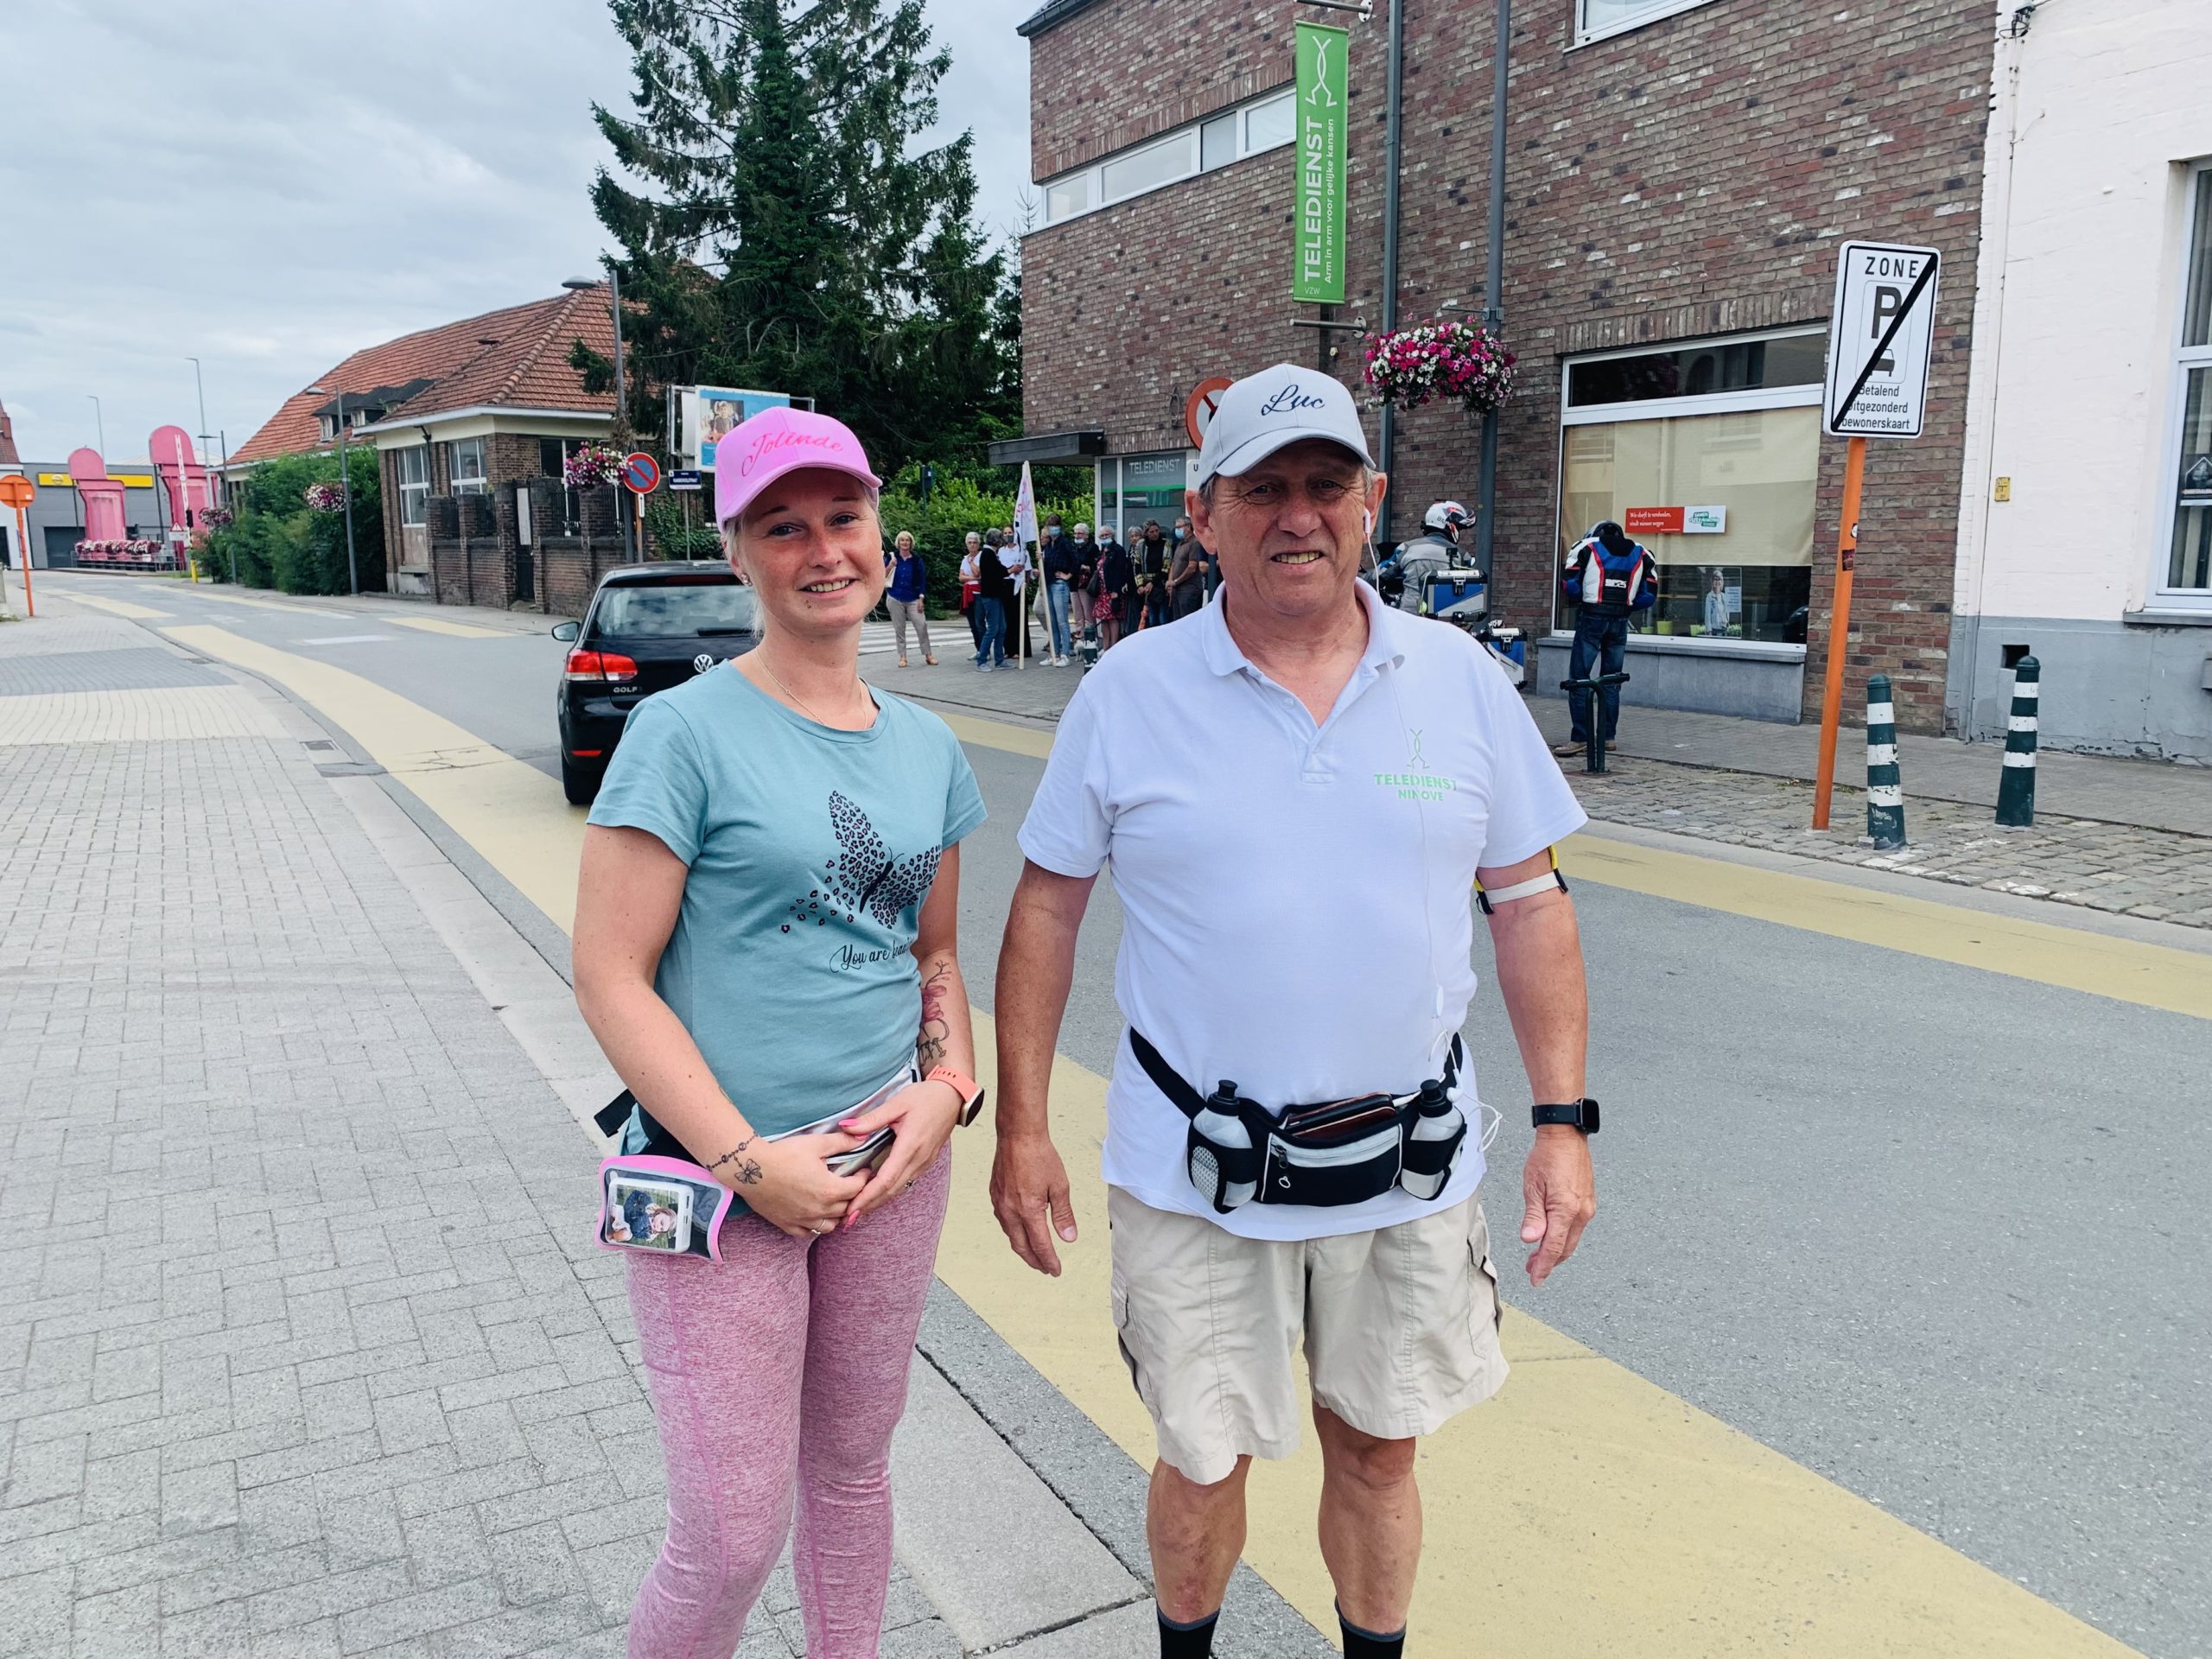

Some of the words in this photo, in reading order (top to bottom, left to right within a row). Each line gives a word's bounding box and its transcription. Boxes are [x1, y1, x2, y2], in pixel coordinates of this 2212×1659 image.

[1326, 161, 1335, 196] gelijke
[1304, 115, 1323, 283] TELEDIENST
[1325, 248, 1332, 258] in
[1865, 256, 1918, 278] ZONE
[1871, 285, 1903, 340] P
[1261, 384, 1325, 416] Luc
[1859, 385, 1900, 397] Betalend
[1841, 416, 1910, 429] bewonerskaart
[741, 431, 843, 477] Jolinde
[1128, 458, 1181, 475] TELEDIENST
[1374, 773, 1457, 791] TELEDIENST
[830, 944, 867, 973] You
[868, 949, 890, 963] are
